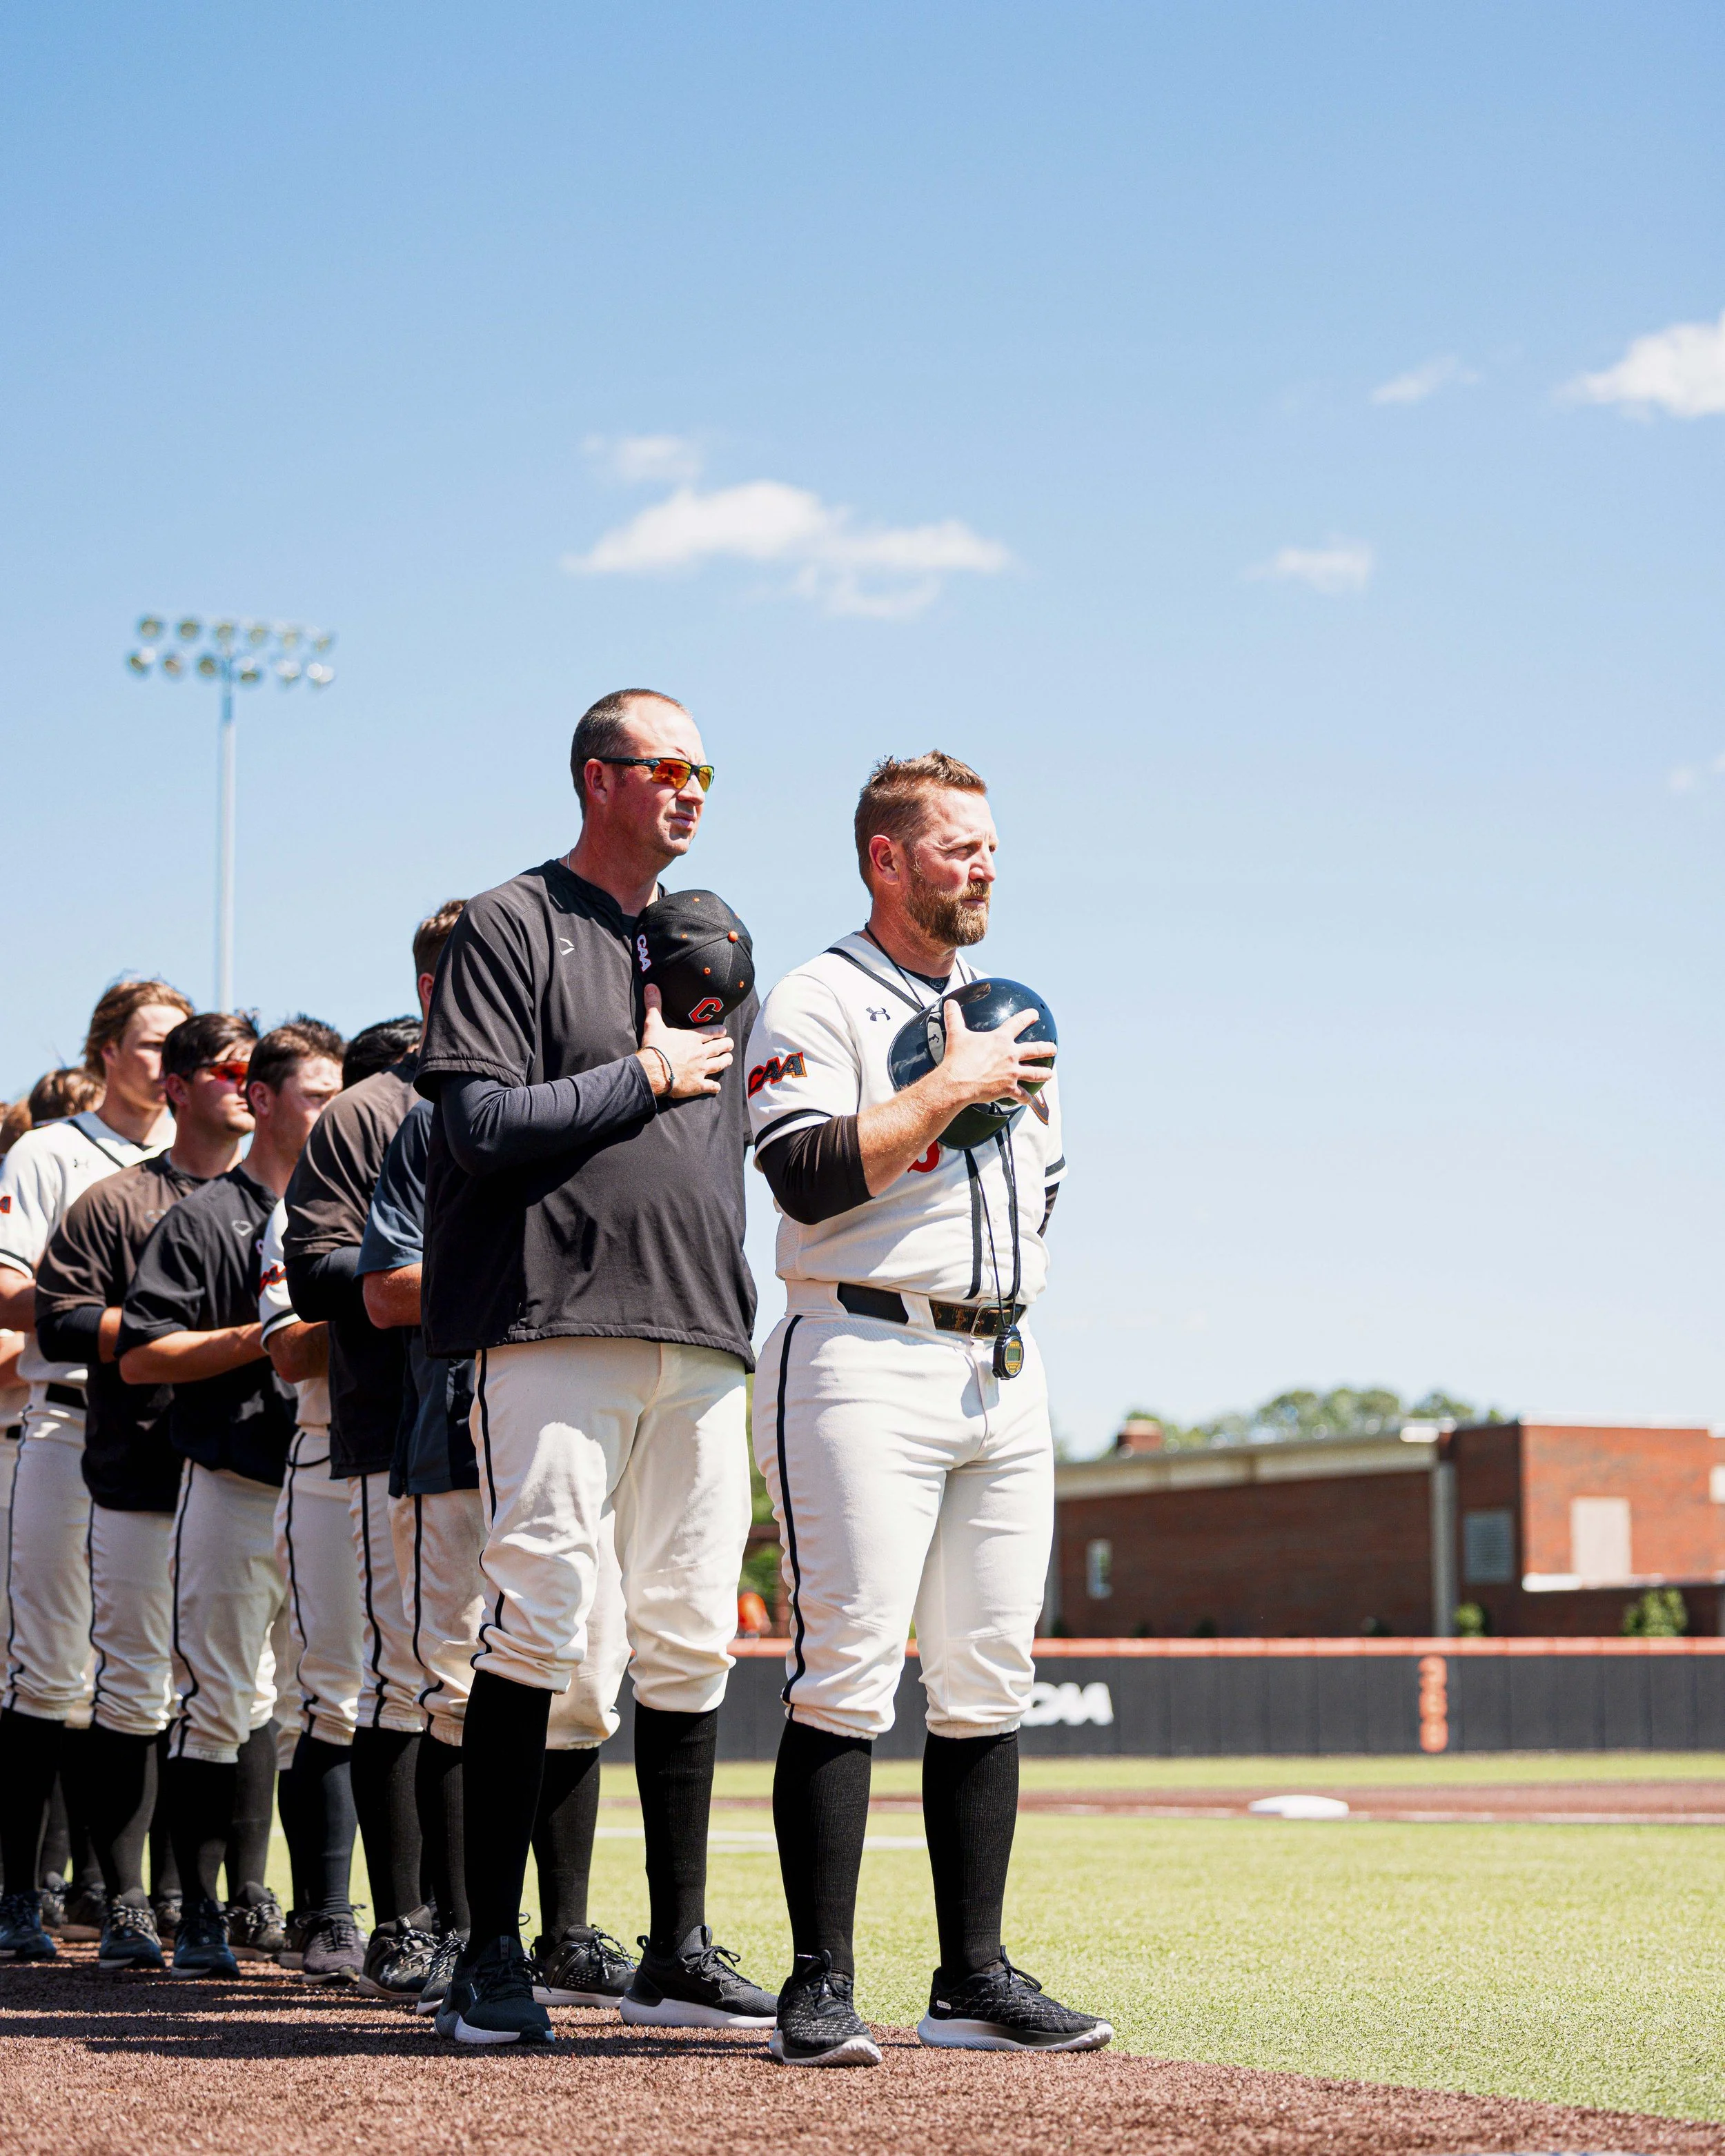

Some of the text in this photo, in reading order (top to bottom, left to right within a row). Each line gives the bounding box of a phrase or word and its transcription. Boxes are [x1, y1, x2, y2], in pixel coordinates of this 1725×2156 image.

[636, 933, 652, 972] CAA
[688, 997, 724, 1023] C
[747, 1051, 808, 1100] CAA
